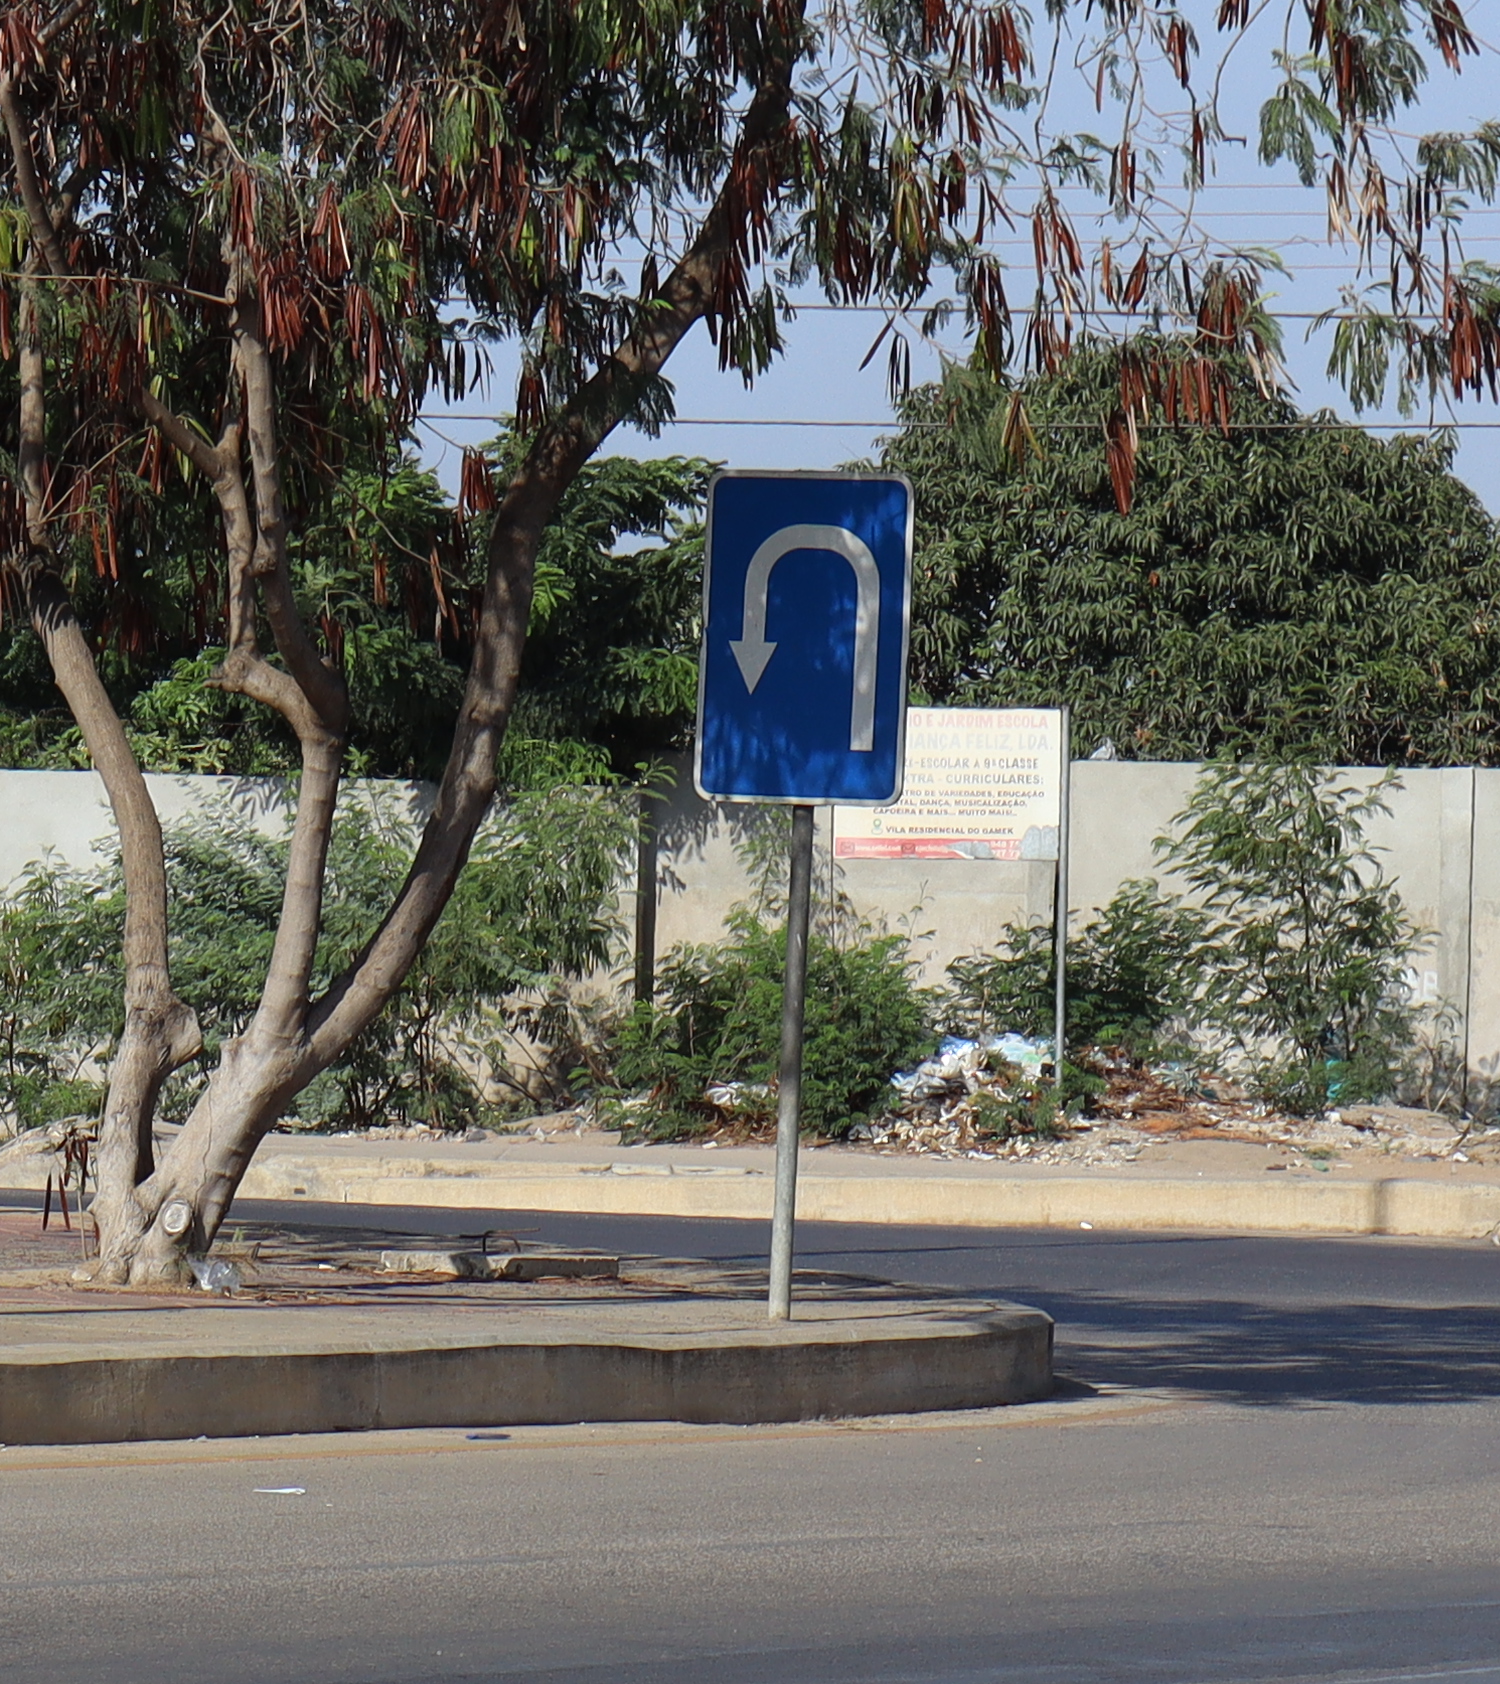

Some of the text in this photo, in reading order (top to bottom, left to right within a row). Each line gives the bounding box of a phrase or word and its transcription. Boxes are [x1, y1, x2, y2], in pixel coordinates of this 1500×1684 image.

[926, 713, 934, 728] E
[937, 713, 994, 728] JARDIM
[997, 714, 1049, 729] ESCOLA
[909, 732, 1053, 752] IANÇA FELIZ, LDA.
[998, 757, 1039, 769] CLASSE
[905, 773, 934, 784] XTRA
[946, 773, 1044, 785] CURRICULARES:
[924, 789, 937, 797] DE
[997, 790, 1045, 799] EDUCAÇÃO
[873, 807, 917, 815] CAPOEIRA
[958, 808, 986, 816] MUITO
[885, 826, 905, 834] VILA
[908, 826, 966, 835] RESIDENCIAL
[967, 827, 979, 835] DO
